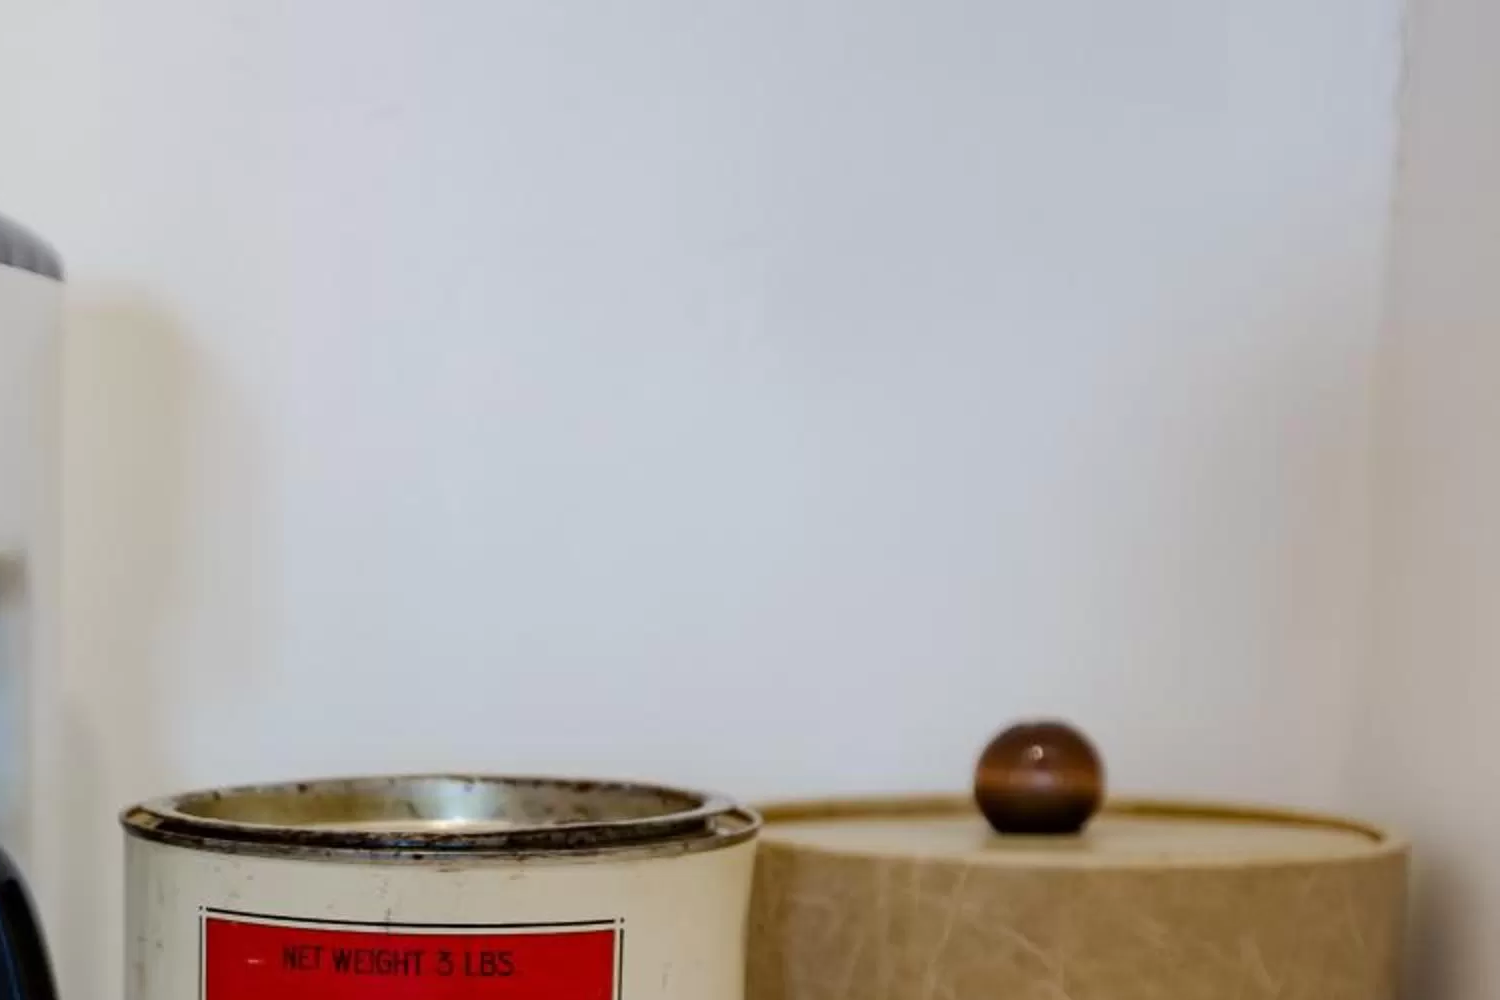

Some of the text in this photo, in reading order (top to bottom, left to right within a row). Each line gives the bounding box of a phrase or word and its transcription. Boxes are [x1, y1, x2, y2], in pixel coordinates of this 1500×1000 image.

[282, 945, 323, 971] NET
[331, 949, 426, 977] WEIGHT
[437, 951, 454, 977] 3
